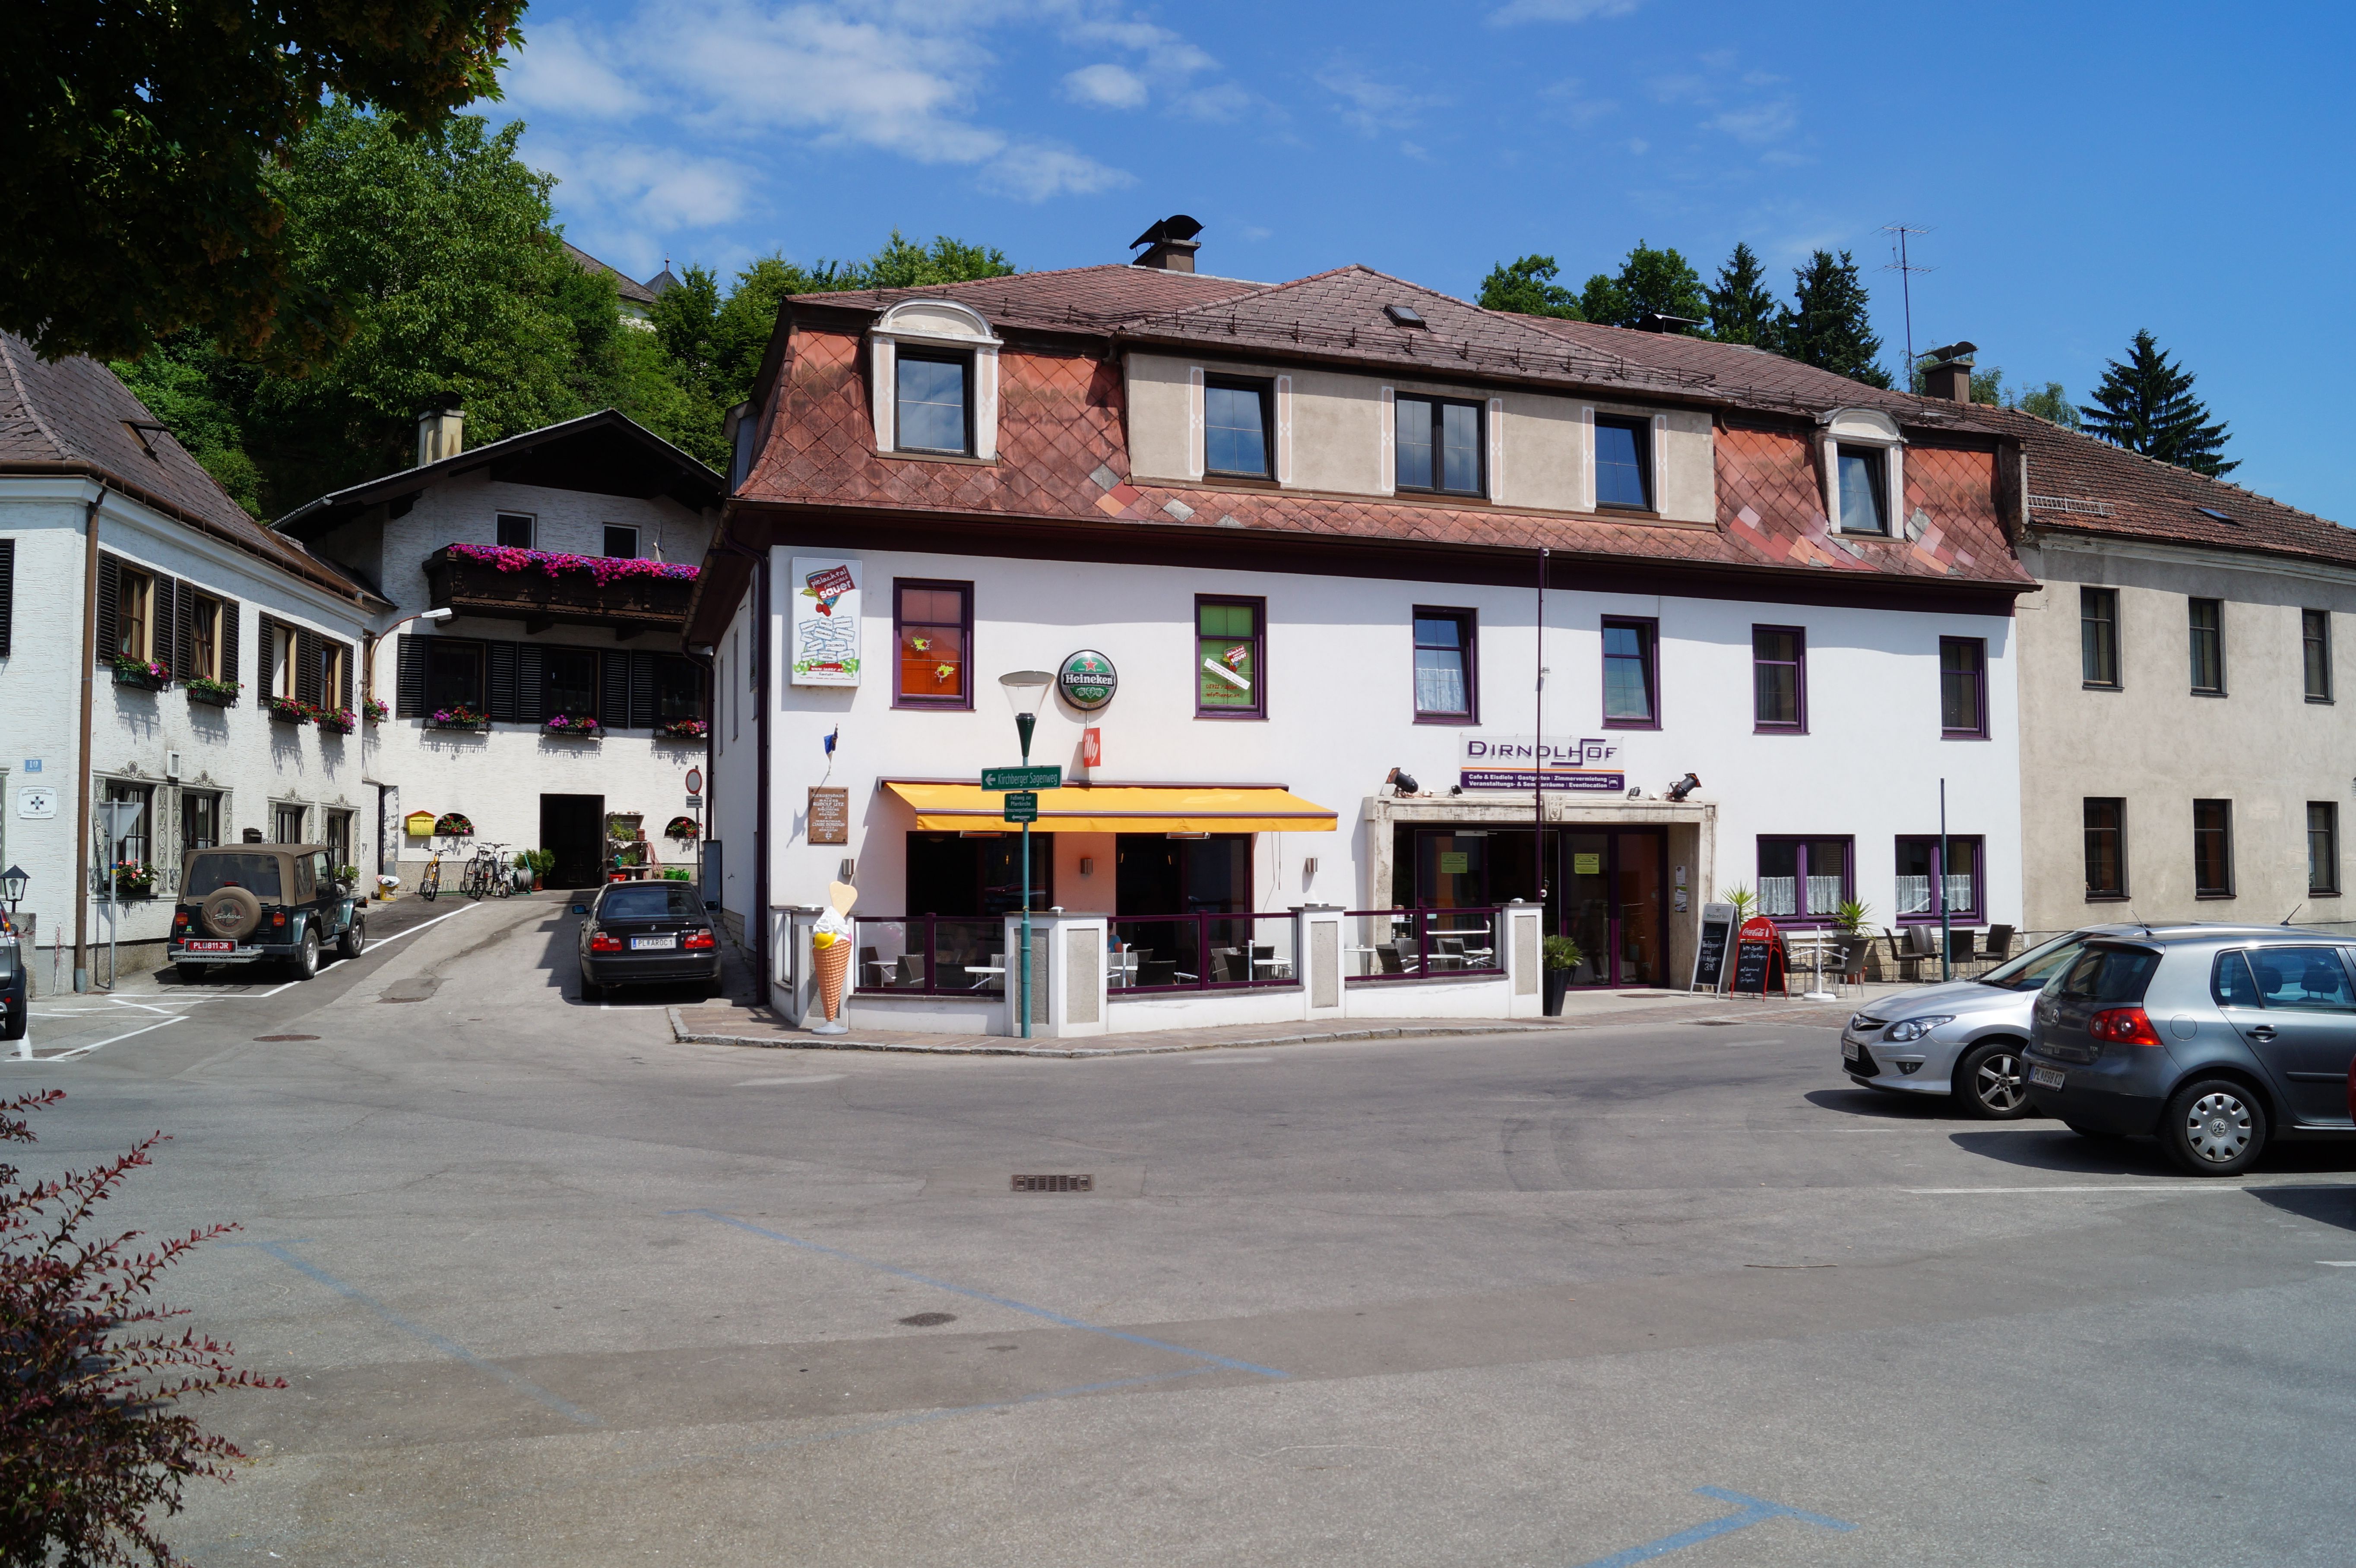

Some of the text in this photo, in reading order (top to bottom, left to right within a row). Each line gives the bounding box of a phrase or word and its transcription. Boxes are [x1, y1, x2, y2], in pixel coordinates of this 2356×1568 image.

[811, 568, 846, 588] pielachtal
[824, 575, 849, 589] FAHRSCHULE
[820, 580, 851, 598] sauer
[1231, 652, 1246, 663] sauer
[1065, 674, 1113, 685] Heineken
[1084, 733, 1099, 764] illy
[998, 772, 1058, 787] Kirchberger Sagenweg
[2033, 1068, 2040, 1080] PL
[2053, 1073, 2063, 1085] KD
